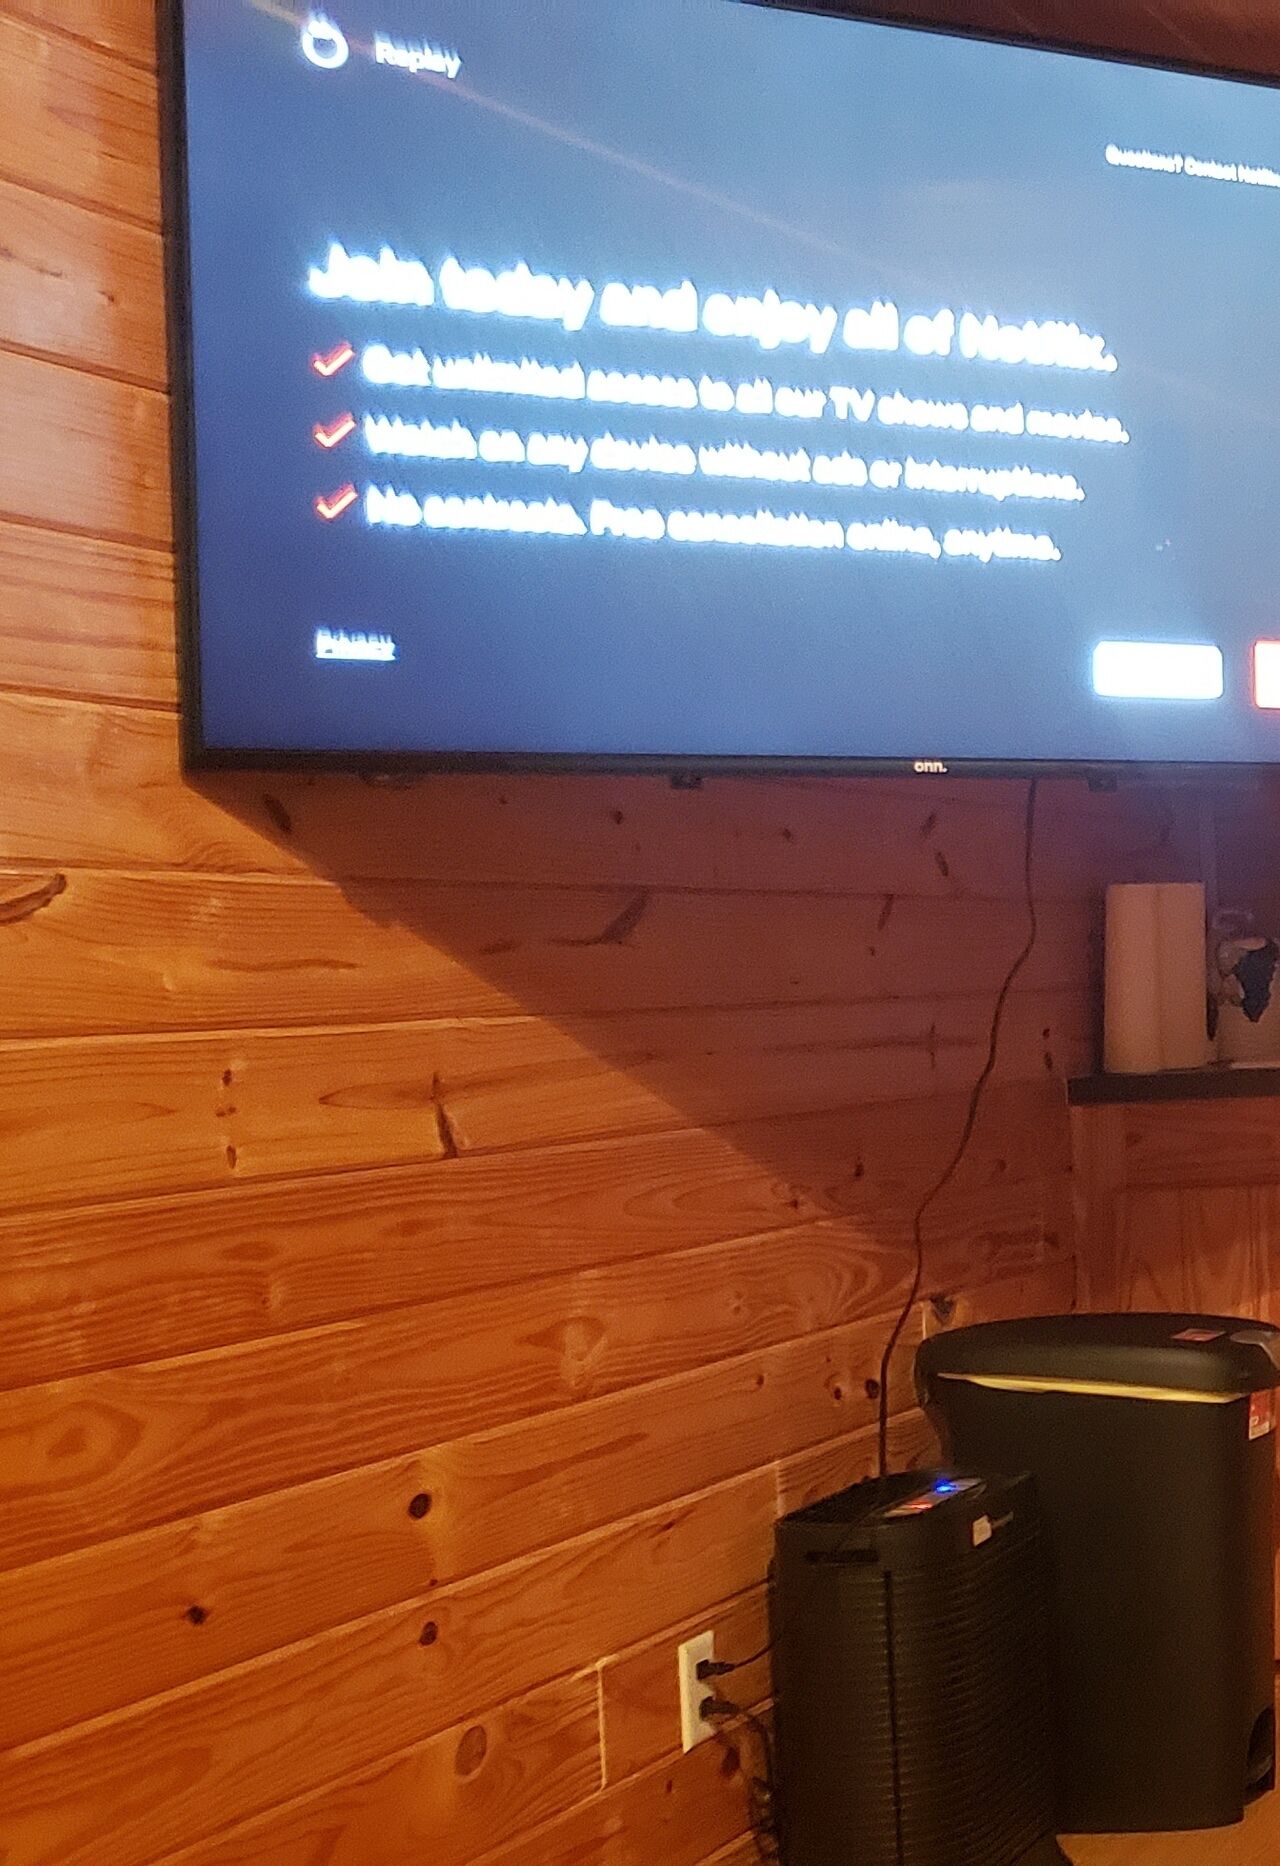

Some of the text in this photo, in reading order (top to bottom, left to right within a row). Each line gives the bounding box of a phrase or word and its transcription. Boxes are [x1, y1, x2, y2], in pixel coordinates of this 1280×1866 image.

[375, 36, 462, 79] Replay
[308, 242, 435, 306] Join
[438, 256, 595, 331] today
[599, 279, 698, 333] and
[701, 287, 838, 354] enjoy
[842, 299, 900, 351] all
[903, 308, 955, 356] of
[698, 374, 736, 412] to
[735, 377, 774, 414] all
[774, 385, 827, 419] our
[828, 385, 876, 422] TV
[969, 401, 1025, 436] and
[478, 429, 526, 462] on
[526, 432, 589, 473] any
[869, 458, 903, 489] or
[589, 498, 666, 540] Free
